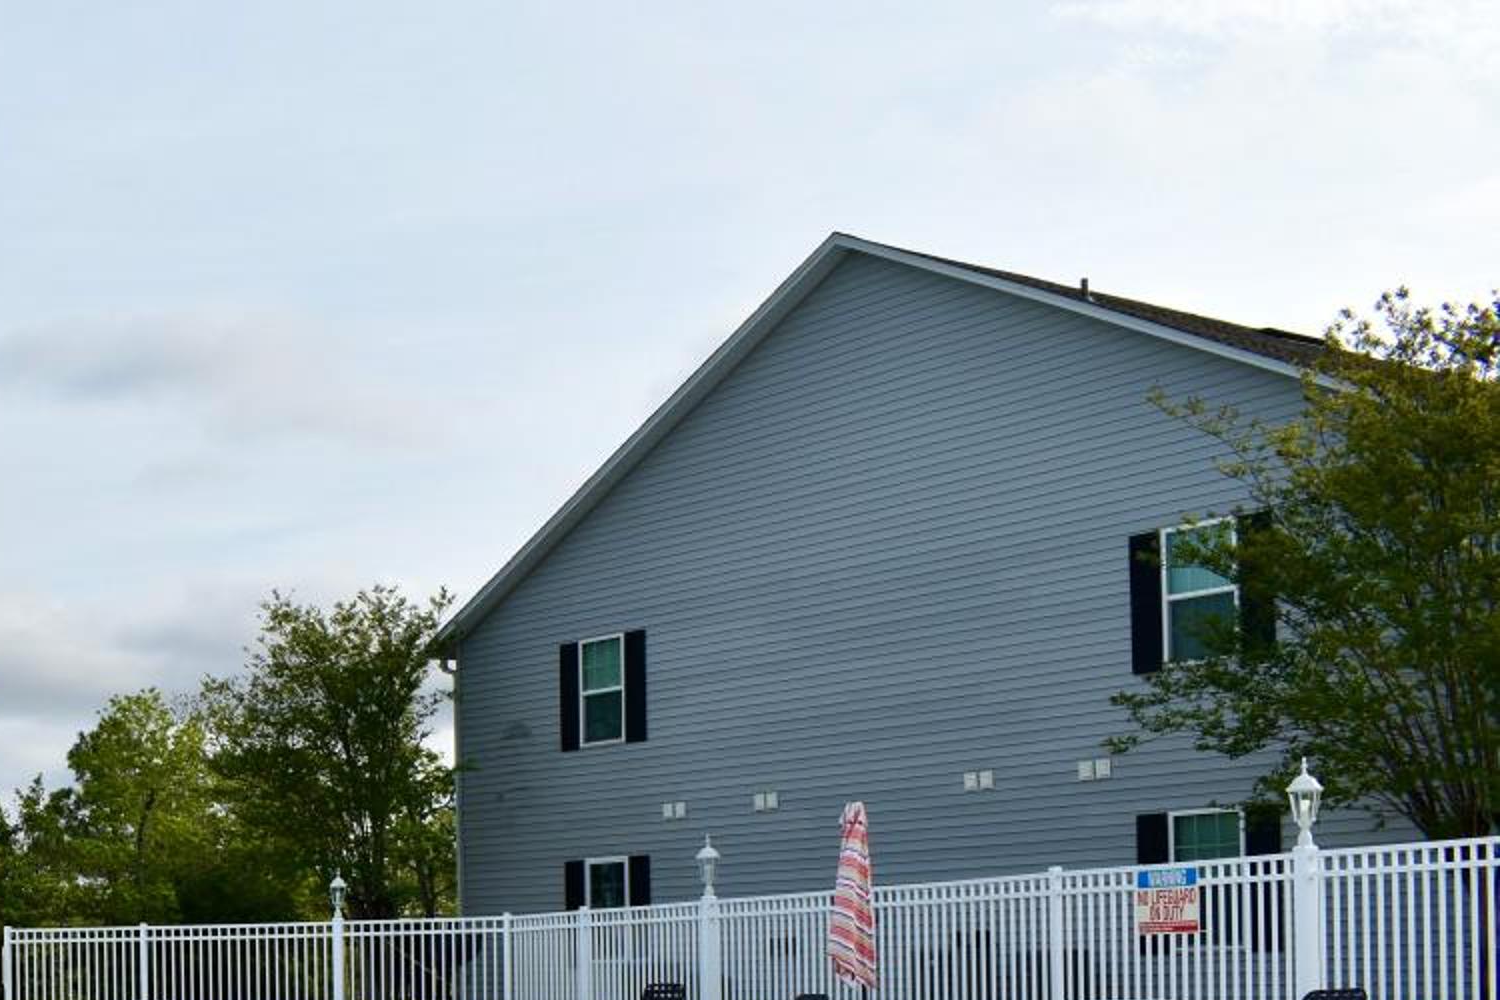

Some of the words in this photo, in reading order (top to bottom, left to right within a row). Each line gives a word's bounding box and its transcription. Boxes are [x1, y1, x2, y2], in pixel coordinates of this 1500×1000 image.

[1138, 890, 1149, 906] NO
[1151, 887, 1197, 905] LIFEGUARD
[1150, 904, 1161, 920] ON
[1163, 904, 1184, 920] DUTY
